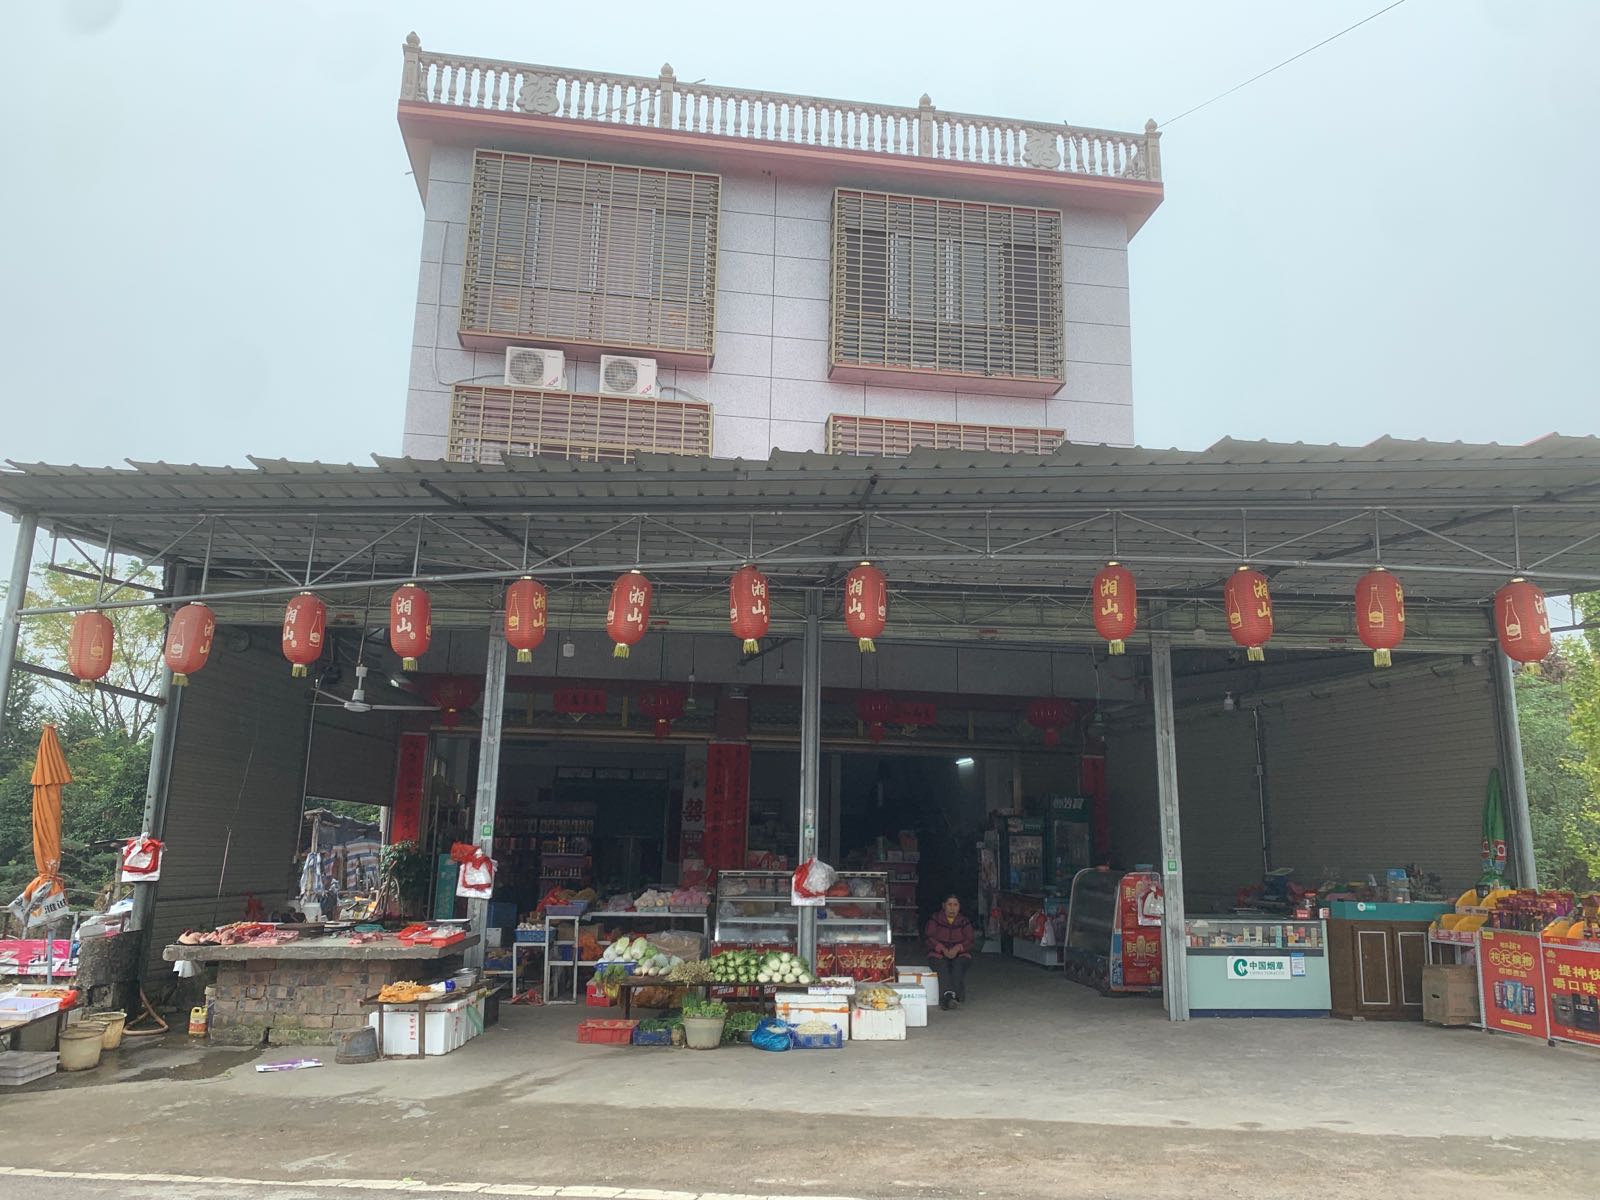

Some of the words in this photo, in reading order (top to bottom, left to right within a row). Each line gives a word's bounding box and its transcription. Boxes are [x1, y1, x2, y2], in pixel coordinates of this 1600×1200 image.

[627, 586, 646, 624] 湘山
[751, 579, 766, 615] 湘山
[848, 576, 863, 614] 湘山
[1101, 578, 1119, 616] 湘山
[396, 596, 412, 634] 湘山
[1249, 960, 1285, 971] 中国烟草
